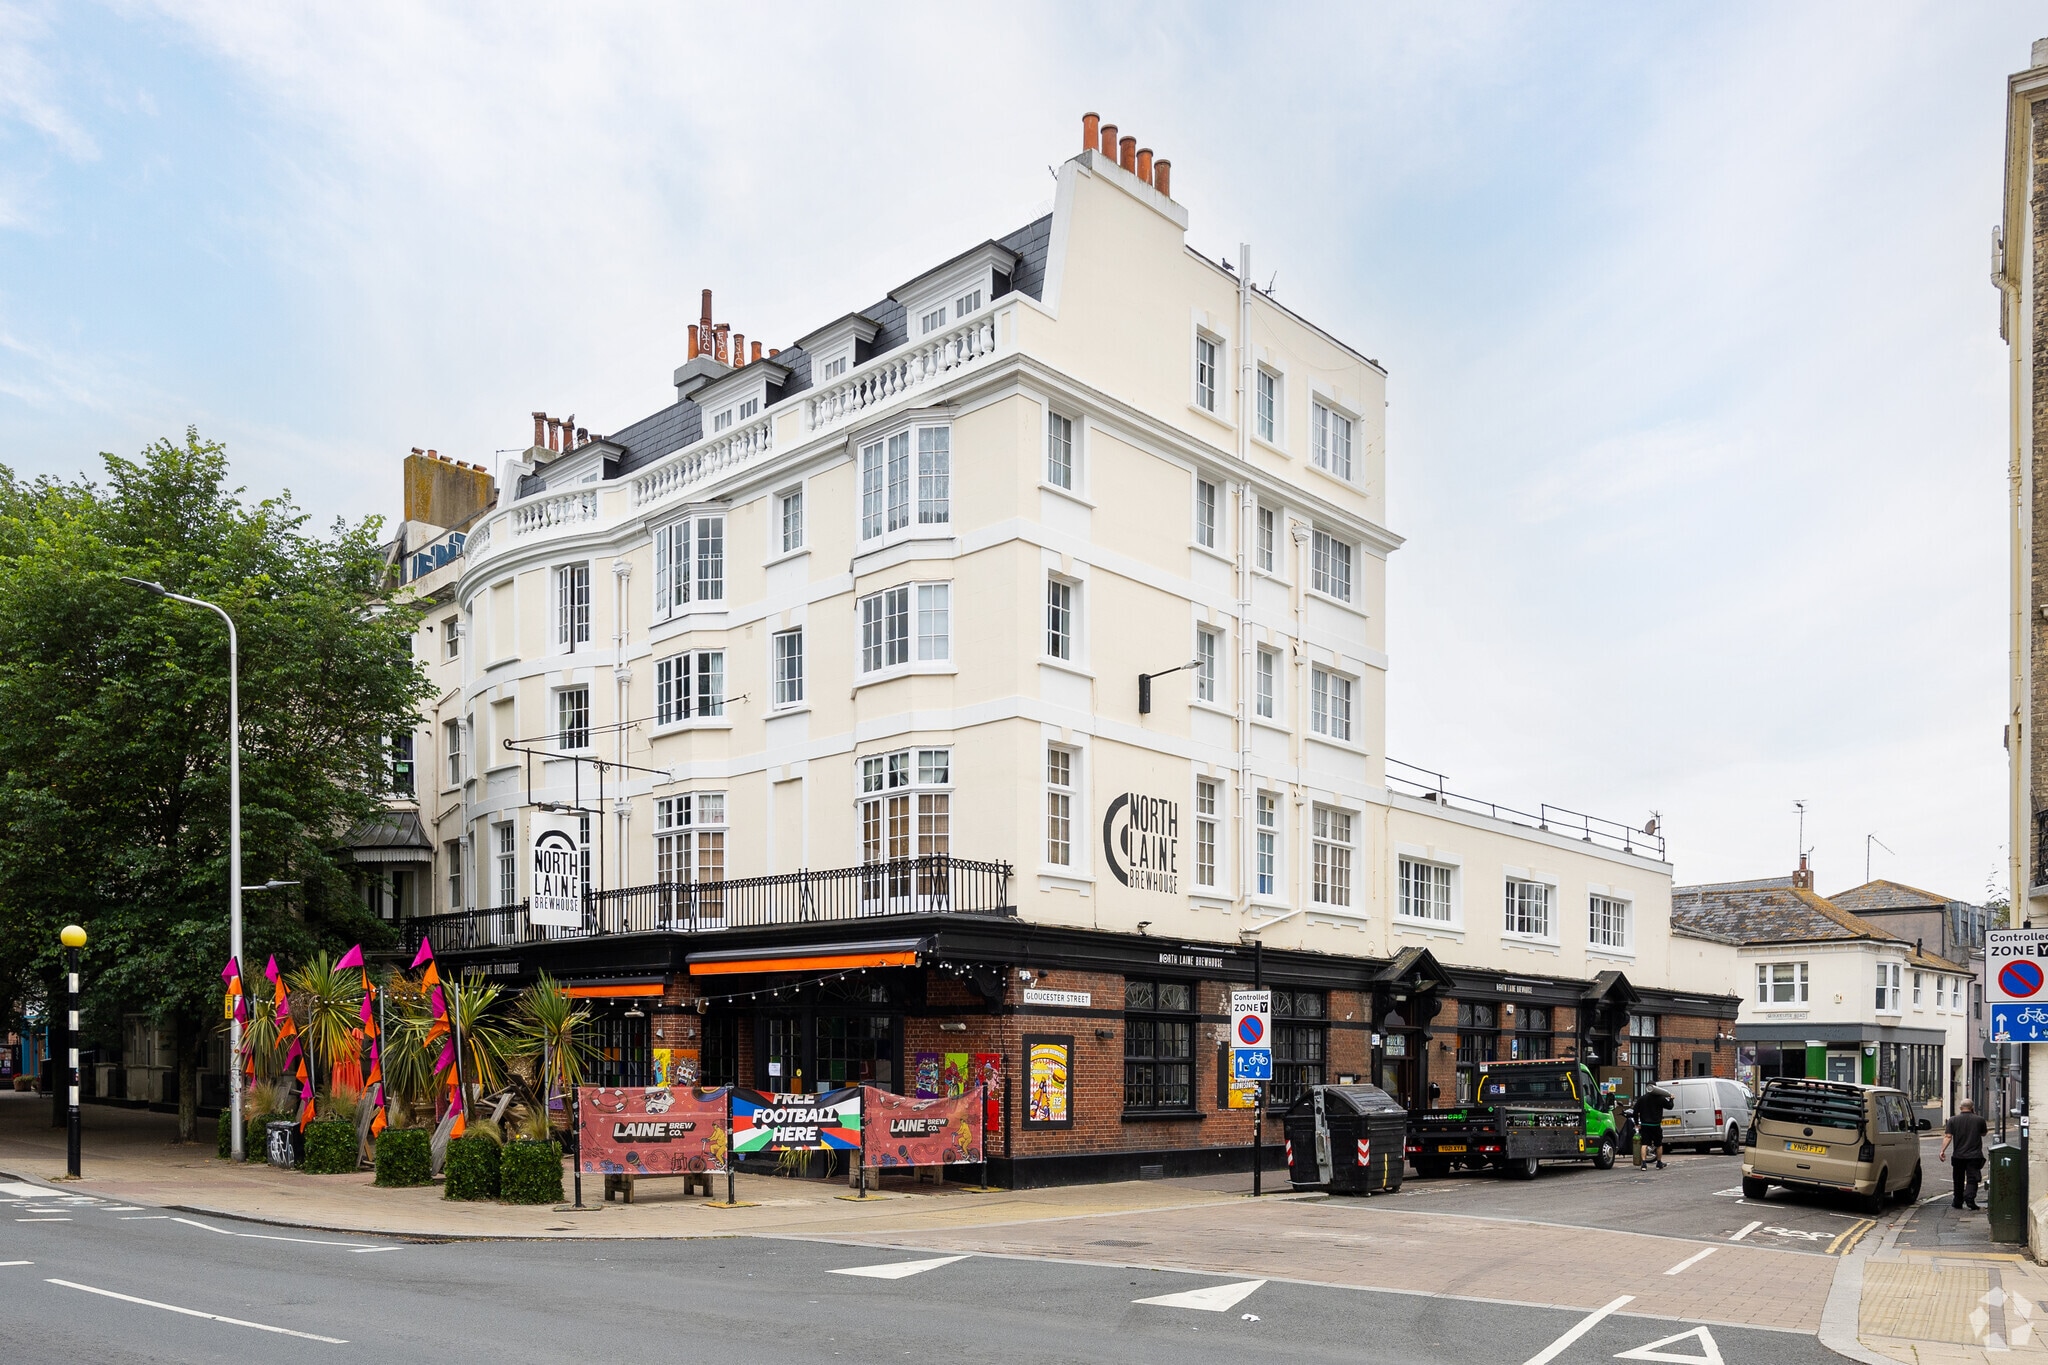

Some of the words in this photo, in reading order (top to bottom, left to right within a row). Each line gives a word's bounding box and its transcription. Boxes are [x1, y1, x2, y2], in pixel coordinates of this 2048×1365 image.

[1130, 792, 1177, 838] NORTH
[1130, 831, 1177, 873] LAINE
[534, 849, 578, 876] NORTH
[534, 873, 578, 899] LAINE
[1130, 869, 1177, 894] BREWHOUSE
[534, 896, 578, 912] BREWHOUSE
[1991, 945, 2035, 956] ZONE
[1159, 953, 1178, 964] NORTH
[1179, 955, 1194, 966] LAINE
[1195, 956, 1223, 968] BREWHOUSE
[1026, 992, 1065, 1002] GLOUCESTER
[1066, 994, 1089, 1004] STREET
[1233, 993, 1269, 1001] Controlled
[1234, 1003, 1259, 1012] ZONE
[1260, 1002, 1268, 1012] Y
[772, 1094, 816, 1105] FREE
[752, 1108, 837, 1123] FOOTBALL
[613, 1122, 667, 1137] LAINE
[890, 1119, 926, 1133] LAINE
[771, 1126, 818, 1142] HERE
